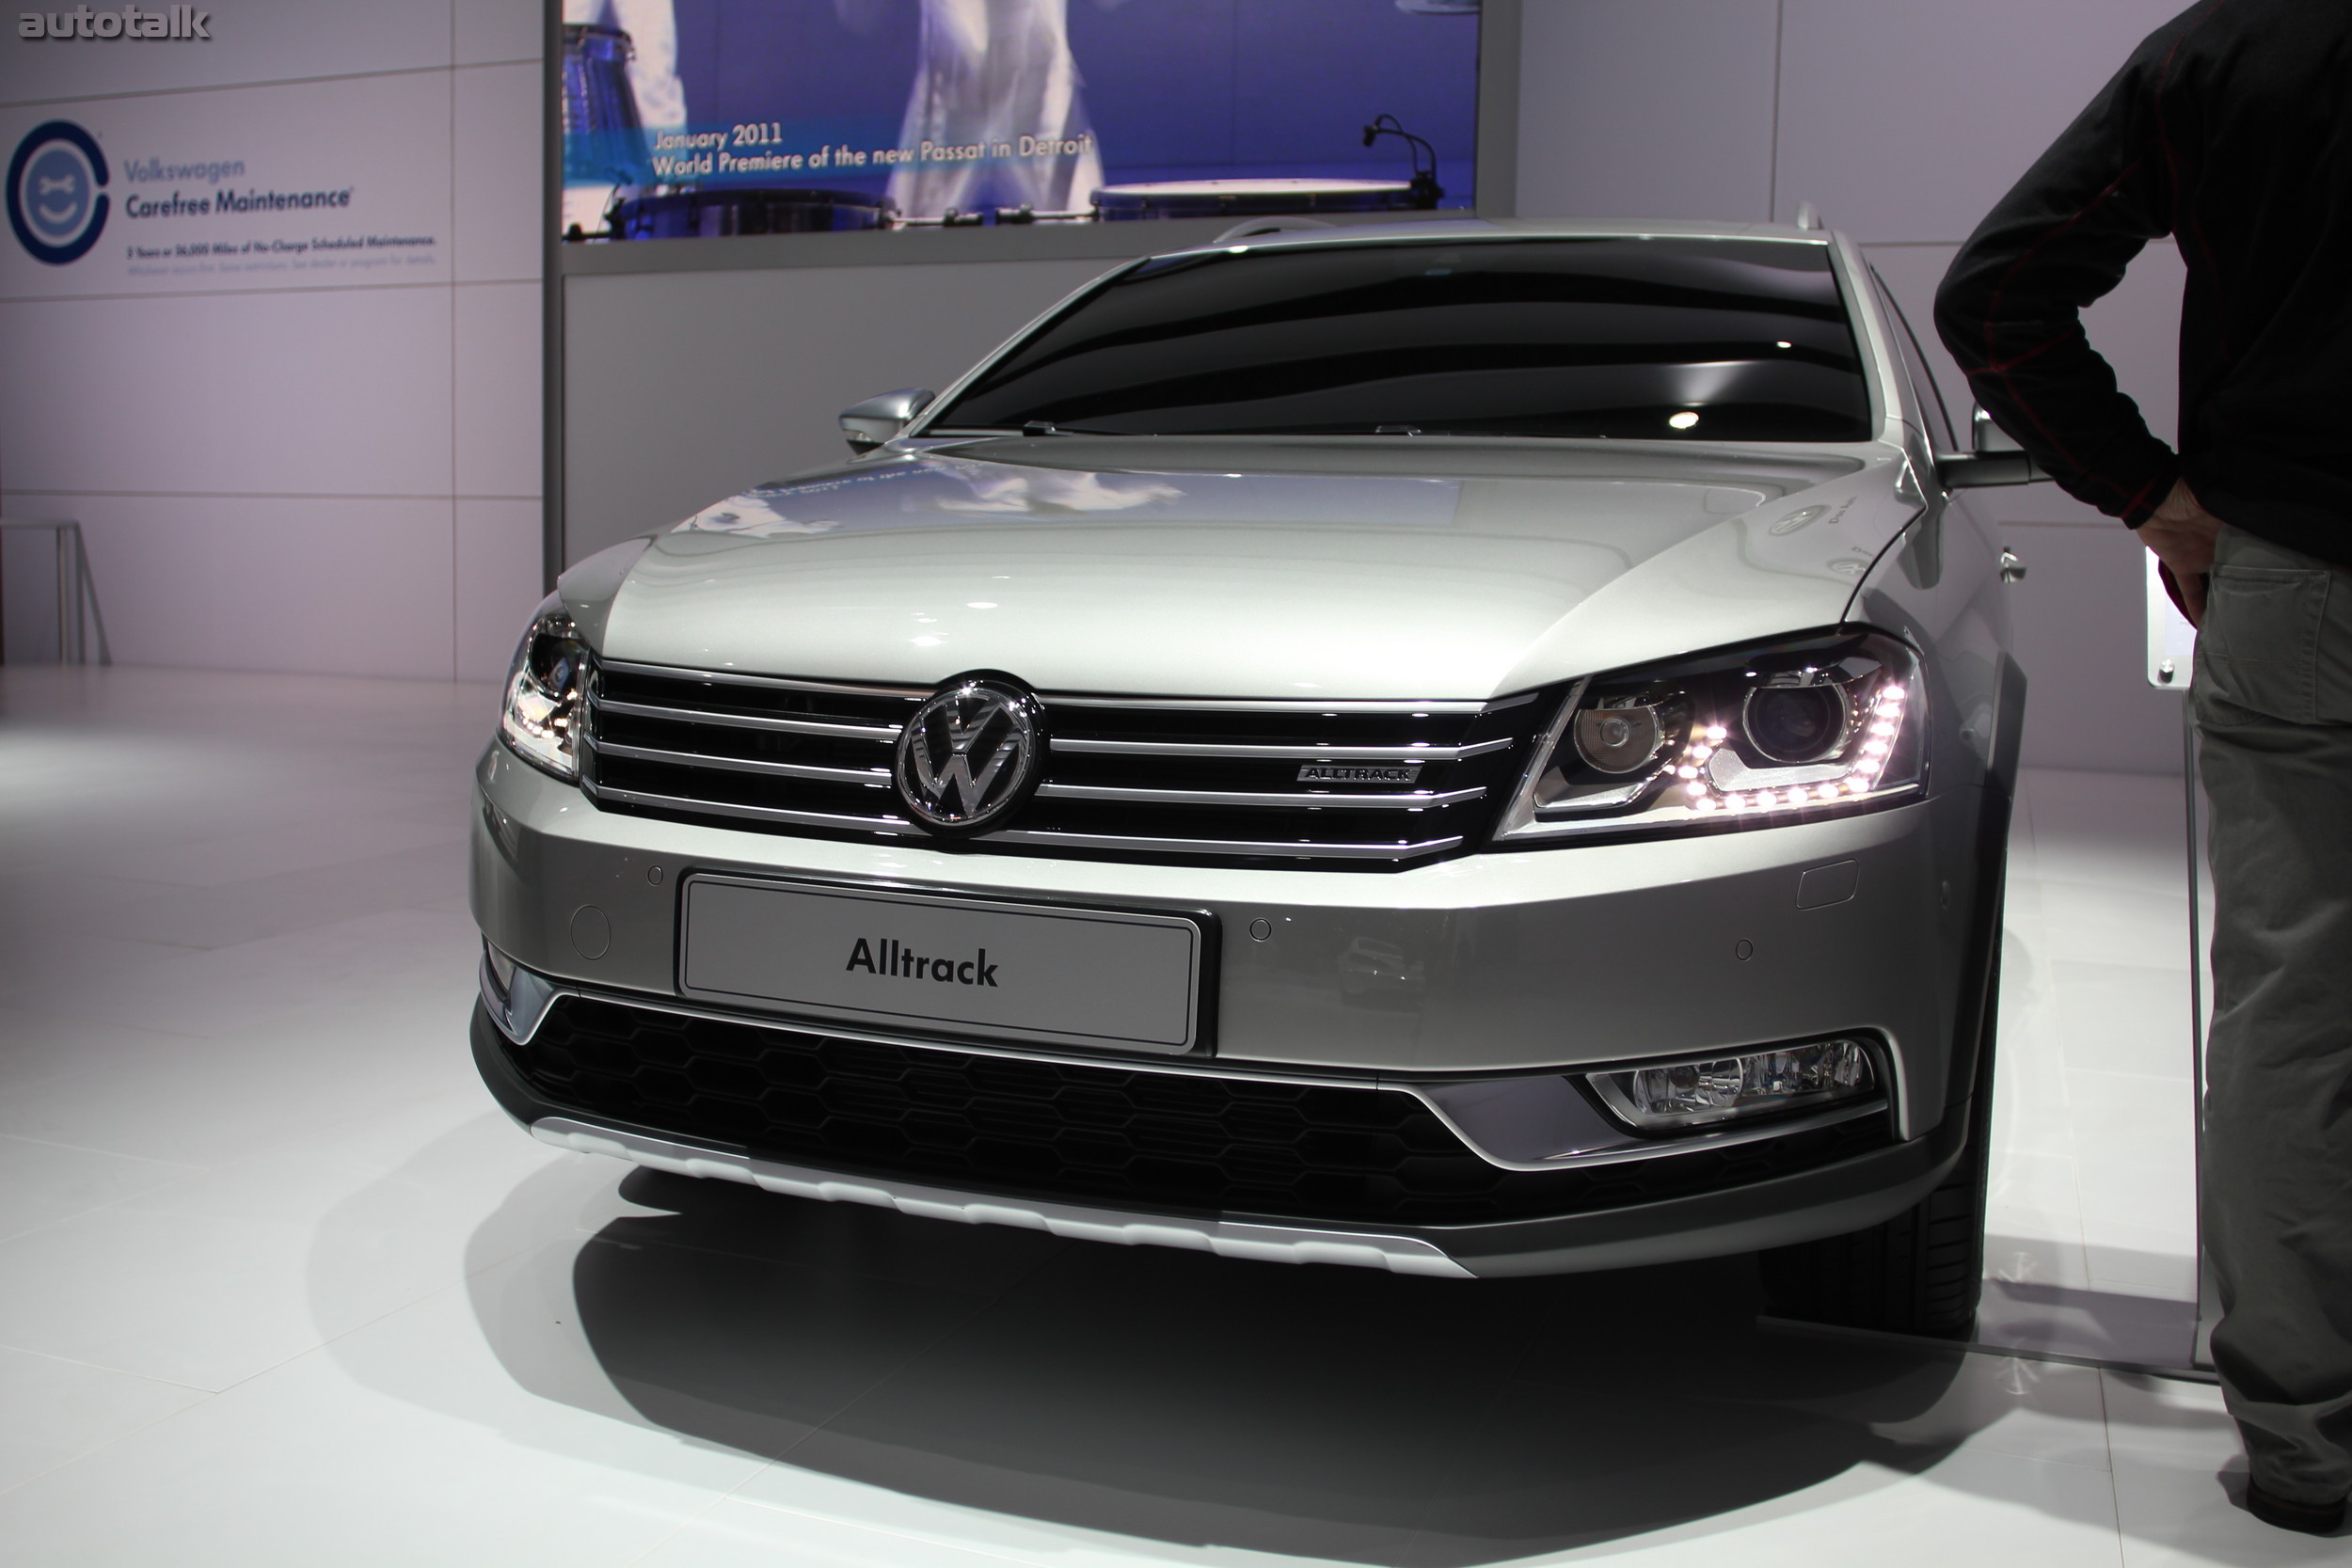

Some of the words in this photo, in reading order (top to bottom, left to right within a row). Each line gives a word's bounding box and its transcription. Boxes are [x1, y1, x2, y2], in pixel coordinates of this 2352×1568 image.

[654, 130, 728, 150] January
[732, 121, 783, 147] 2011
[652, 152, 714, 176] World
[718, 150, 803, 174] Premiere
[808, 145, 831, 168] of
[834, 144, 866, 167] the
[872, 149, 914, 165] new
[919, 140, 986, 162] Passat
[992, 138, 1011, 157] in
[1019, 134, 1091, 156] Detroit
[123, 157, 245, 185] Volkswagen
[125, 190, 211, 218] Carefree
[215, 188, 351, 214] Maintenance
[1304, 768, 1411, 782] ALLTRACK
[846, 938, 998, 988] Alltrack
